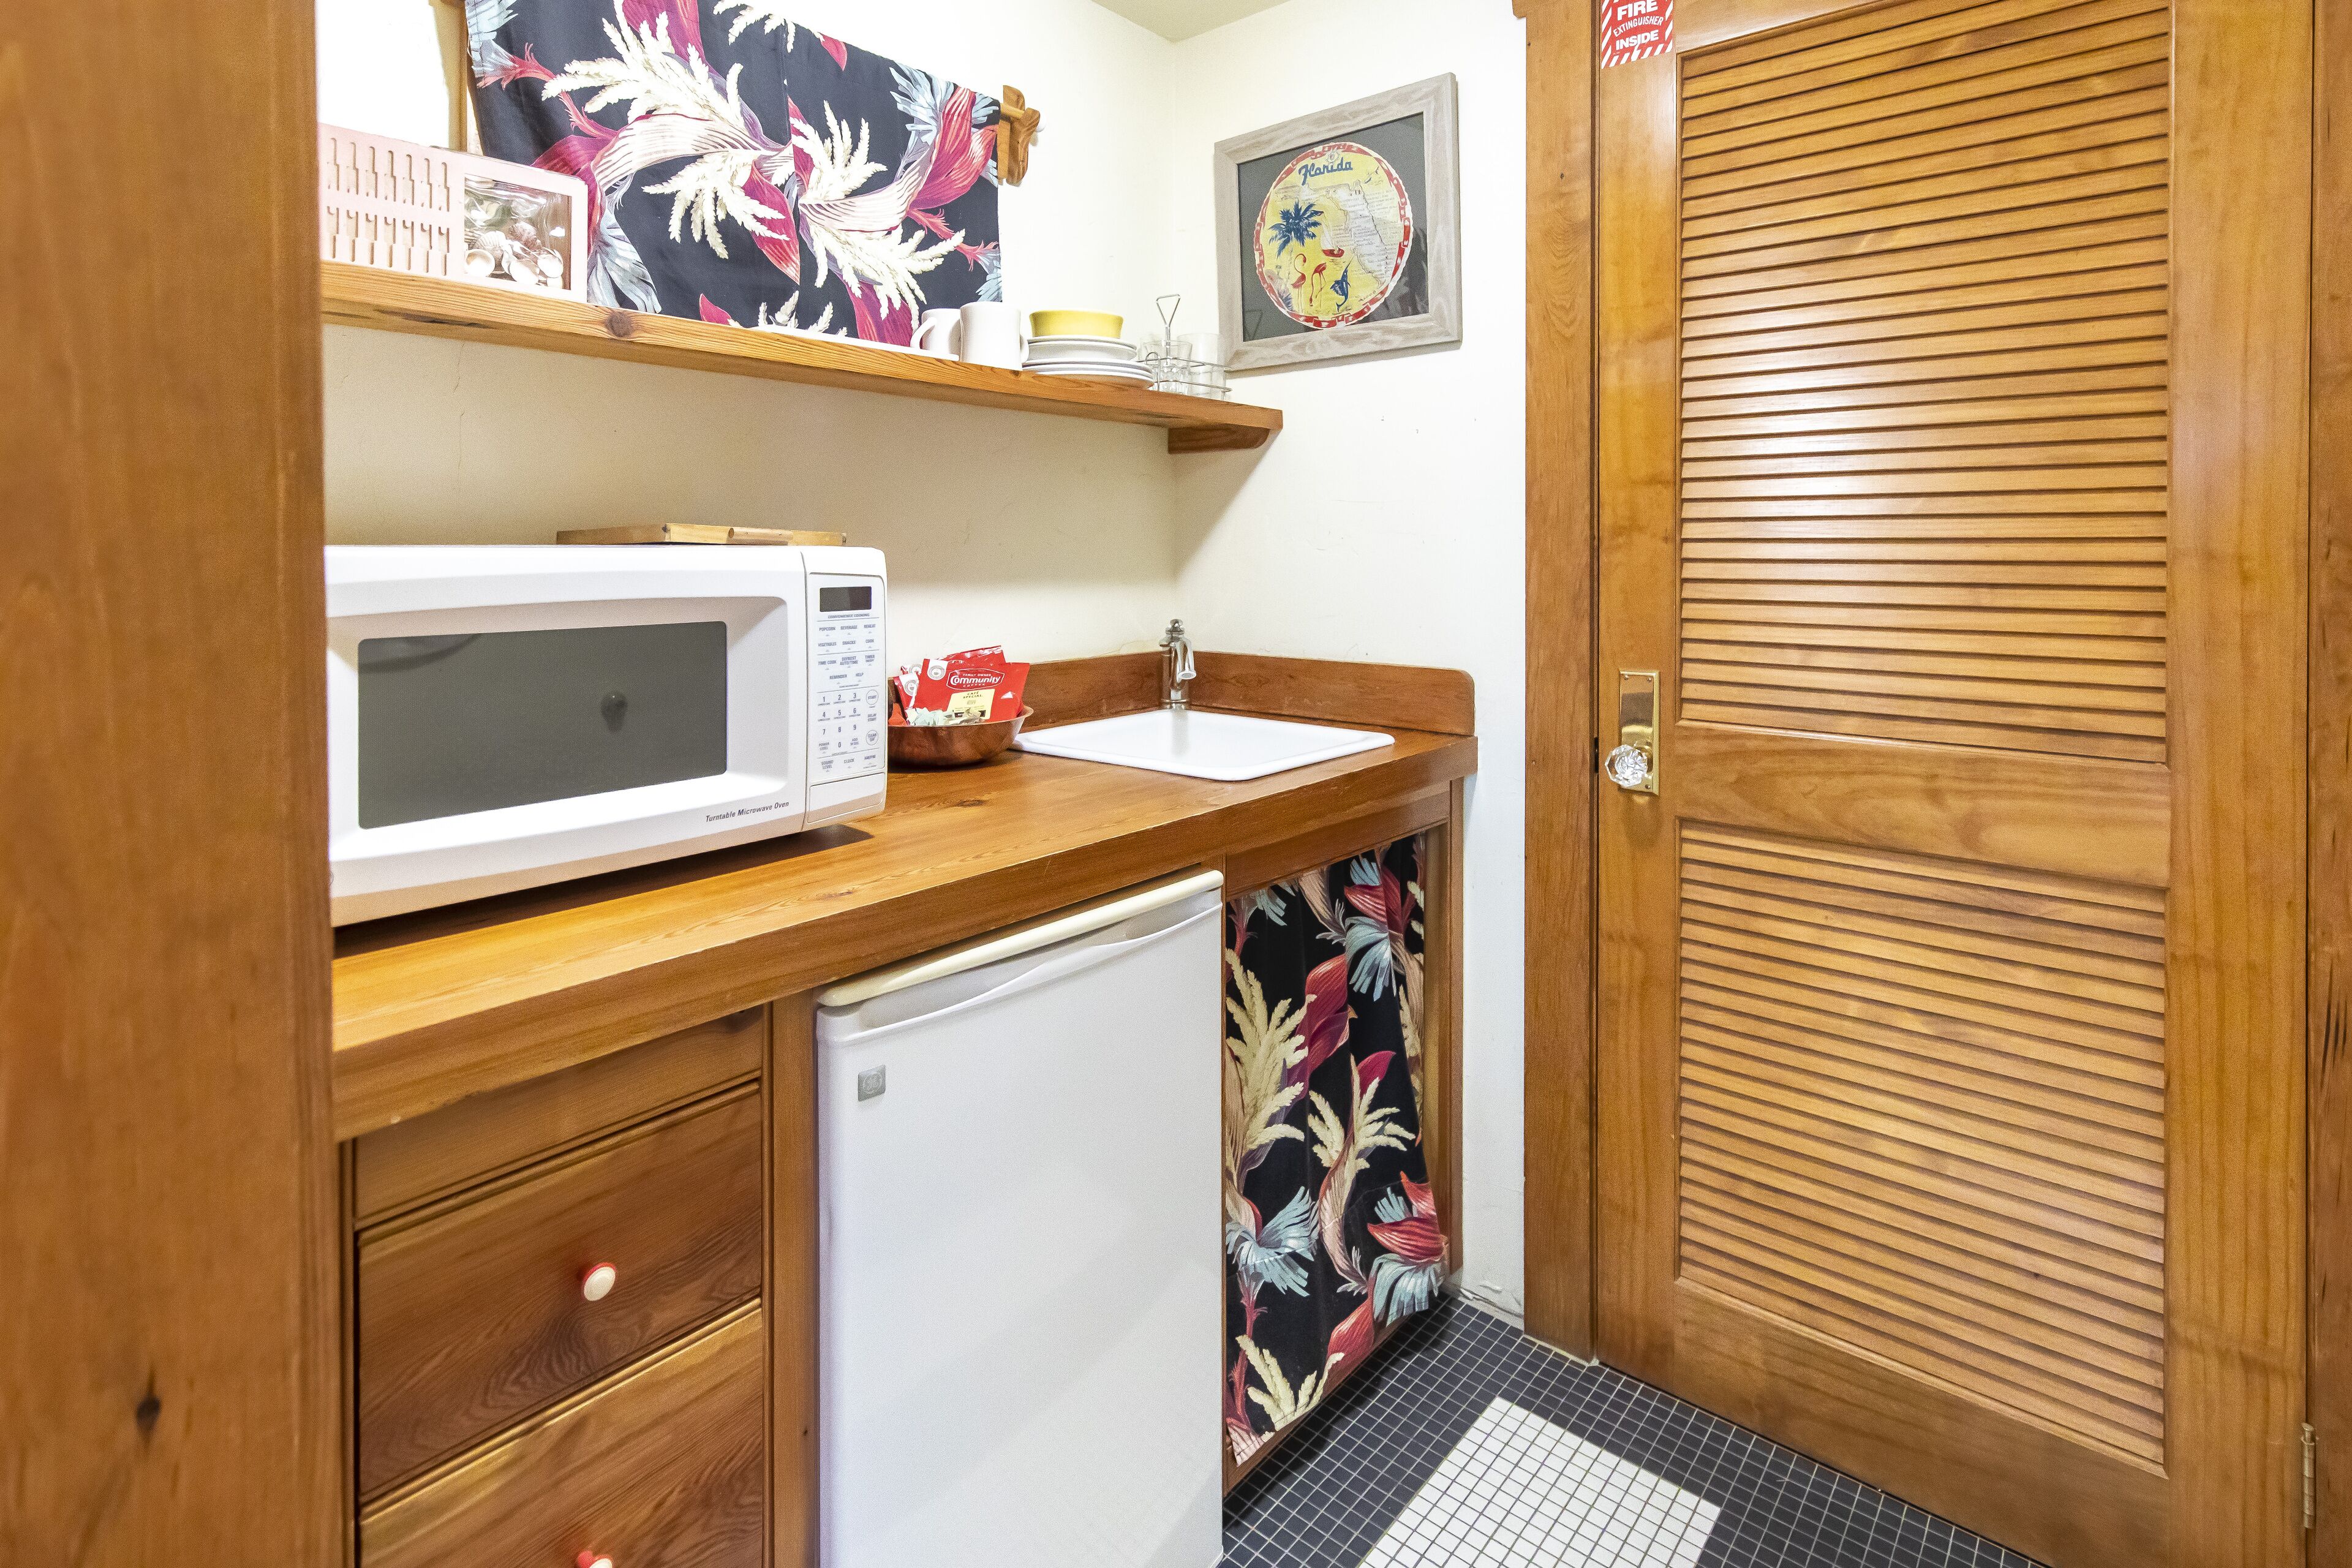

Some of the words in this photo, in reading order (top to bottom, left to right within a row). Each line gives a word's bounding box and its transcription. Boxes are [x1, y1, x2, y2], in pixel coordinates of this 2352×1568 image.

[1617, 0, 1658, 21] FIRE
[1613, 16, 1664, 37] EXTINGUISHER
[1616, 29, 1659, 50] INSIDE
[1298, 160, 1353, 186] Florida
[950, 675, 1001, 685] Community
[706, 812, 735, 822] Turntable
[737, 805, 772, 816] Microwave
